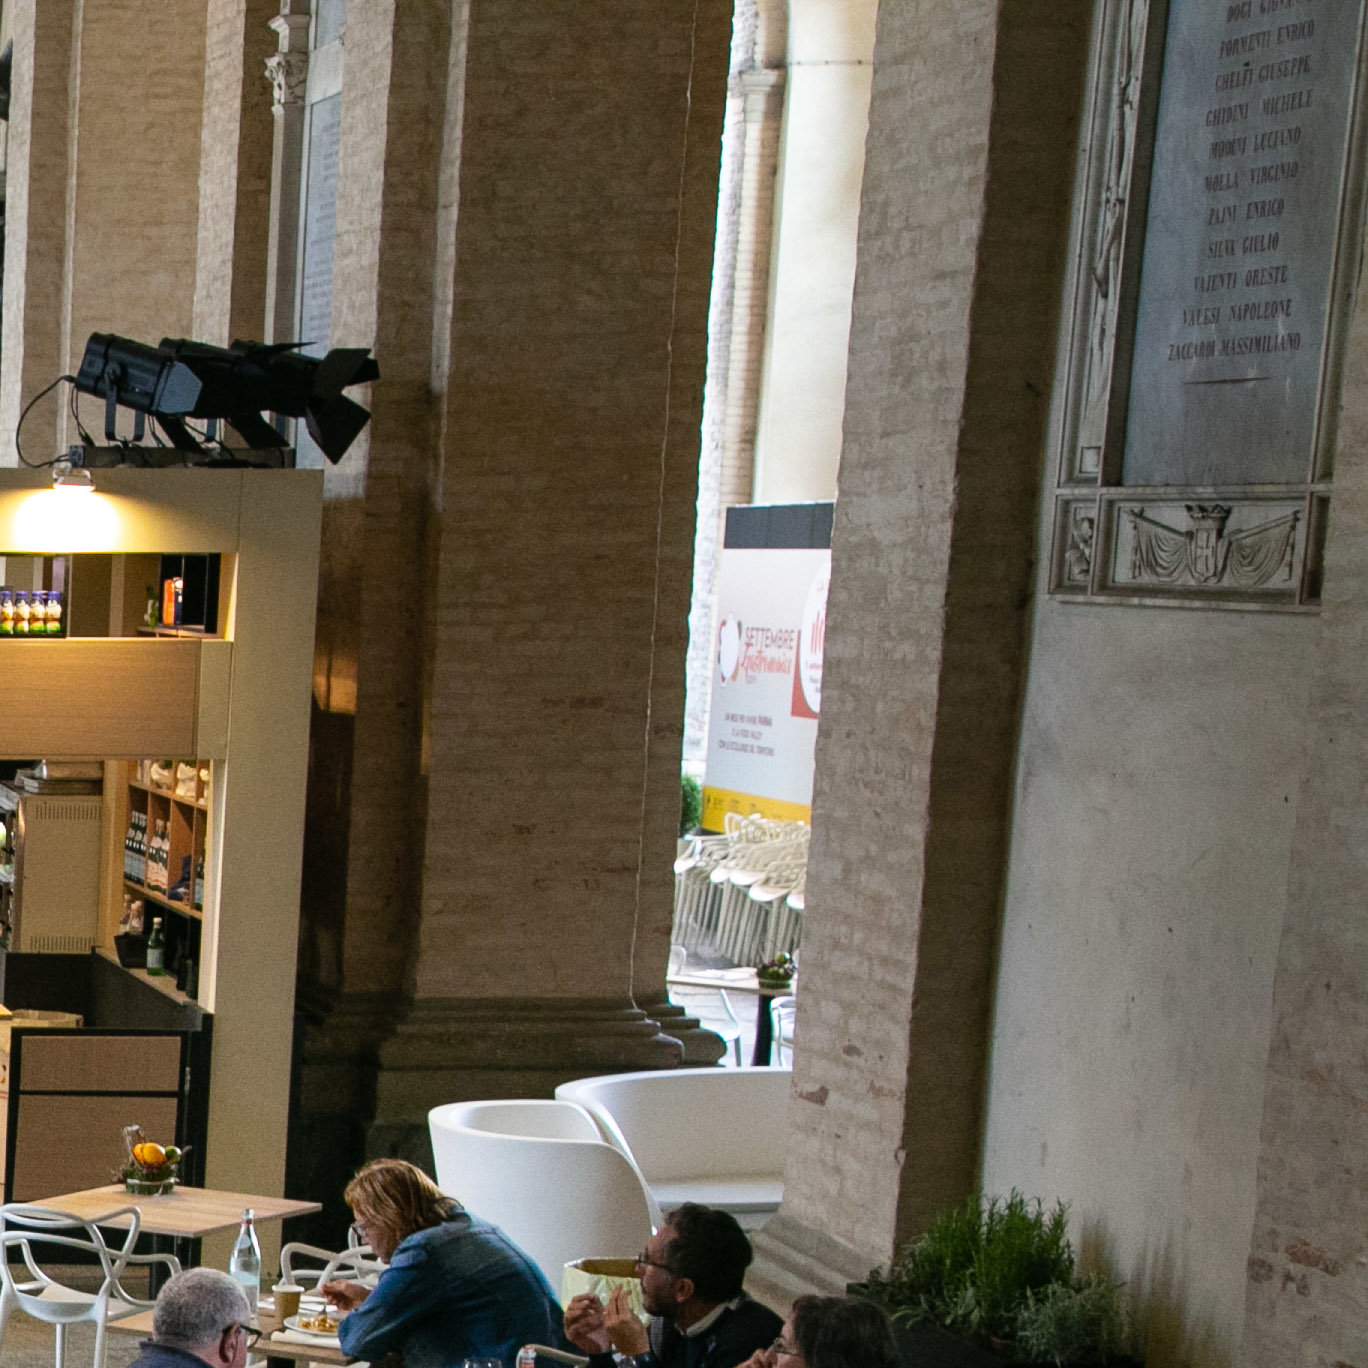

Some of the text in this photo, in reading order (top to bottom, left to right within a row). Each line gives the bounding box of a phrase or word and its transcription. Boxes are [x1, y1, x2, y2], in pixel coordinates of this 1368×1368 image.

[1258, 54, 1312, 83] GIUSEPPE
[1246, 198, 1284, 219] ENRICO
[1245, 265, 1288, 288] ORESTE
[1230, 299, 1292, 322] NAPOLEONE
[745, 627, 795, 651] SETTEMBRE
